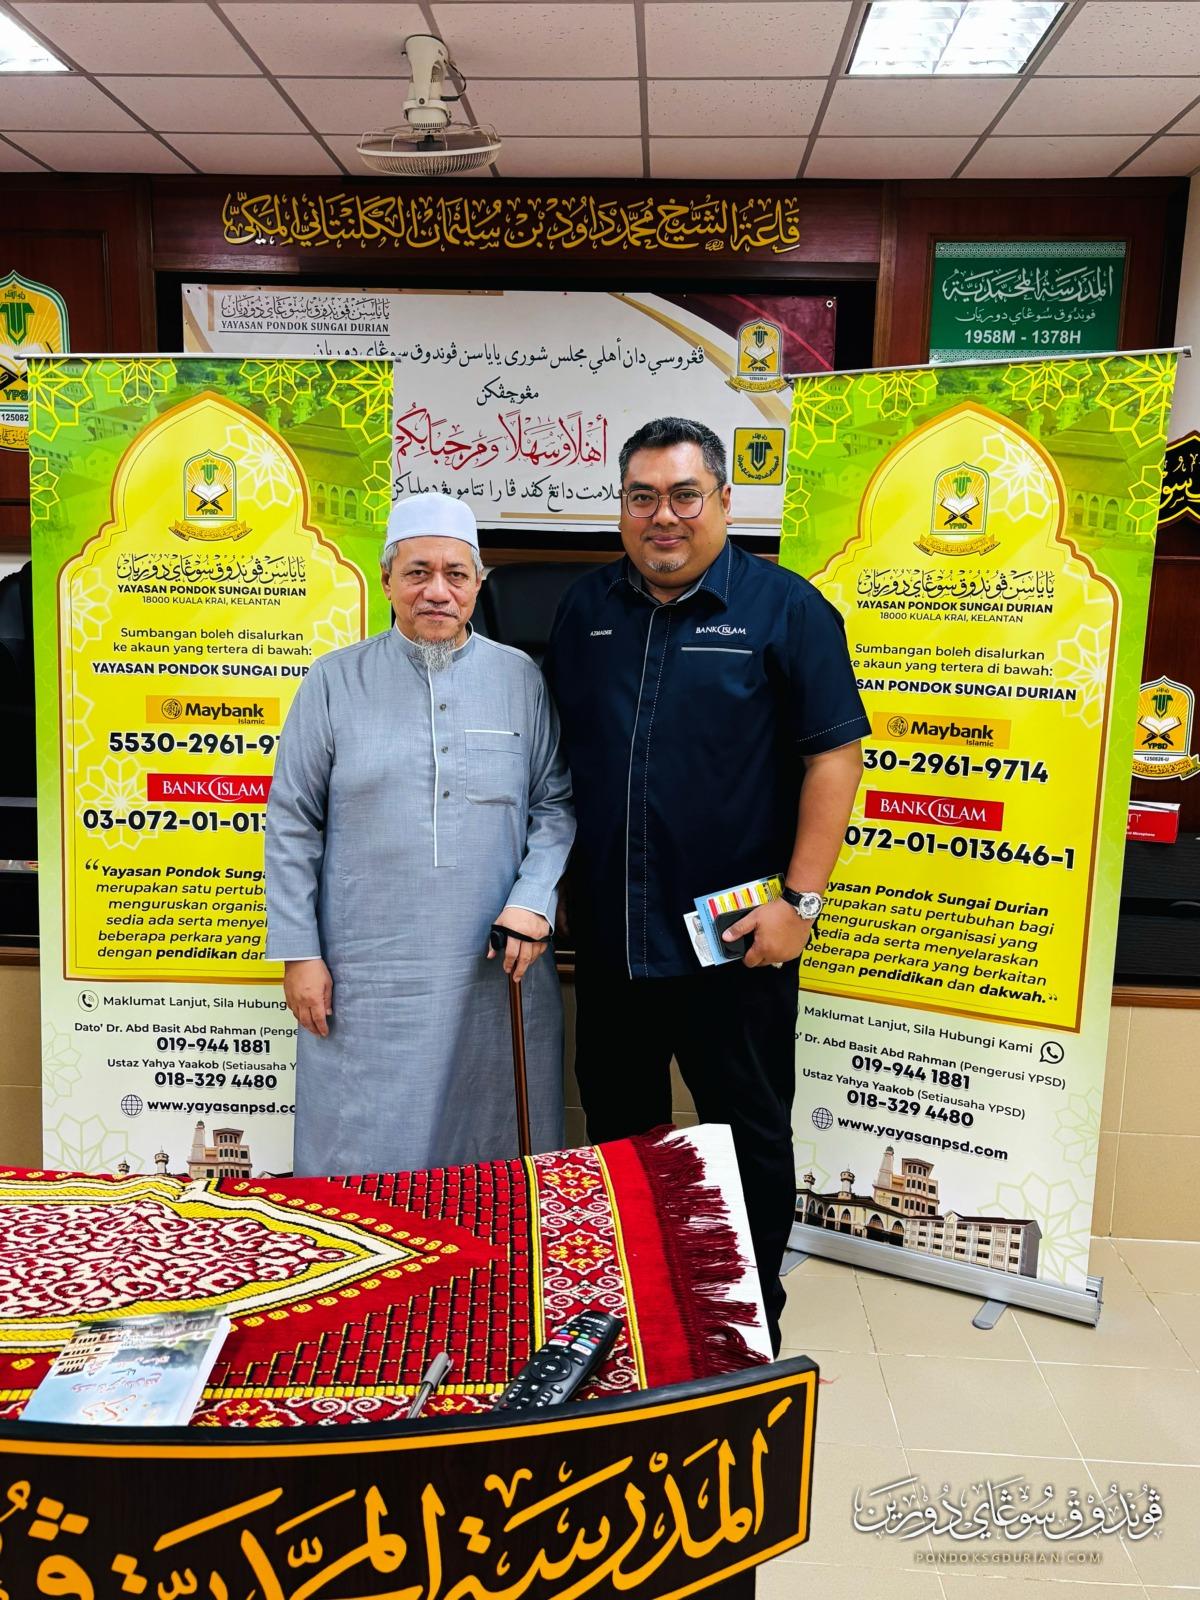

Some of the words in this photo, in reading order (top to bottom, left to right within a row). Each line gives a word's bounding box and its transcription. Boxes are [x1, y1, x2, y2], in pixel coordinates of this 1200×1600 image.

[221, 320, 263, 330] YAYASAN
[267, 321, 308, 331] PONDOK
[311, 322, 347, 332] SUNGAI
[350, 323, 388, 332] DURIAN
[964, 330, 1016, 344] 1958M
[1031, 330, 1081, 344] 1378H
[117, 584, 167, 594] YAYASAN
[170, 585, 216, 594] PONDOK
[218, 586, 261, 595] SUNGAI
[264, 587, 306, 596] DURIAN
[142, 596, 170, 604] 18000
[172, 596, 203, 604] KUALA
[205, 597, 228, 606] KRAI,
[231, 597, 281, 606] KELANTAN
[857, 600, 905, 609] YAYASAN
[908, 601, 957, 611] PONDOK
[959, 602, 1003, 612] SUNGAI
[1006, 603, 1053, 613] DURIAN
[880, 611, 907, 620] 18000
[909, 613, 942, 621] KUALA
[944, 614, 968, 622] KRAI,
[971, 614, 1023, 623] KELANTAN
[121, 627, 197, 641] Sumbangan
[201, 629, 234, 639] boleh
[238, 629, 303, 641] disalurkan
[696, 626, 718, 635] BANK
[721, 626, 747, 636] ISLAM
[113, 642, 127, 652] ke
[130, 642, 170, 653] akaun
[173, 645, 203, 656] yang
[206, 644, 248, 654] tertera
[252, 644, 263, 654] di
[267, 645, 312, 656] bawah:
[855, 643, 931, 657] Sumbangan
[936, 646, 971, 657] boleh
[974, 647, 1045, 660] disalurkan
[92, 662, 154, 674] YAYASAN
[158, 663, 219, 675] PONDOK
[222, 664, 277, 676] SUNGAI
[863, 658, 902, 669] akaun
[905, 662, 937, 673] yang
[941, 662, 983, 673] tertera
[987, 663, 1000, 674] di
[1004, 664, 1053, 676] bawah:
[888, 680, 952, 694] PONDOK
[955, 683, 1012, 697] SUNGAI
[1016, 686, 1076, 700] DURIAN
[185, 703, 264, 720] Maybank
[911, 721, 993, 740] Maybank
[109, 732, 281, 755] 5530-2961-9
[966, 739, 993, 747] Islamic
[163, 780, 208, 795] BANK
[217, 782, 264, 796] ISLAM
[880, 798, 927, 816] BANK
[936, 803, 987, 823] ISLAM
[166, 866, 221, 878] Pondok
[96, 882, 178, 895] merupakan
[182, 884, 212, 894] satu
[108, 898, 208, 912] menguruskan
[875, 885, 934, 902] Pondok
[937, 893, 991, 910] Sungai
[994, 900, 1048, 917] Durian
[106, 914, 144, 925] sedia
[148, 914, 174, 925] ada
[178, 916, 213, 926] serta
[890, 905, 922, 917] satu
[925, 908, 1017, 931] pertubuhan
[1019, 920, 1055, 937] bagi
[98, 930, 166, 944] beberapa
[169, 931, 223, 944] perkara
[225, 935, 261, 947] yang
[818, 912, 917, 935] menguruskan
[920, 923, 996, 946] organisasi
[997, 937, 1038, 952] yang
[97, 946, 152, 960] dengan
[156, 947, 237, 960] pendidikan
[853, 933, 880, 945] ada
[883, 938, 920, 950] serta
[924, 941, 1038, 969] menyelaraskan
[802, 941, 870, 962] beberapa
[873, 953, 929, 968] perkara
[931, 961, 969, 977] yang
[973, 964, 1046, 986] berkaitan
[803, 955, 855, 974] dengan
[858, 965, 943, 987] pendidikan
[947, 979, 975, 992] dan
[103, 996, 166, 1006] Maklumat
[169, 997, 210, 1009] Lanjut,
[213, 997, 234, 1008] Sila
[238, 998, 288, 1011] Hubung
[75, 1022, 103, 1032] Dato'
[106, 1024, 123, 1032] Dr.
[125, 1024, 149, 1033] Abd
[152, 1024, 181, 1033] Basit
[184, 1025, 207, 1034] Abd
[210, 1025, 256, 1035] Rahman
[804, 1006, 864, 1024] Maklumat
[868, 1016, 910, 1033] Lanjut,
[913, 1024, 935, 1036] Sila
[939, 1028, 995, 1049] Hubungi
[999, 1039, 1033, 1053] Kami
[157, 1037, 229, 1052] 019-944
[233, 1039, 270, 1053] 1881
[107, 1059, 139, 1067] Ustaz
[142, 1059, 175, 1070] Yahya
[178, 1060, 219, 1069] Yaakob
[222, 1061, 287, 1071] (Setiausaha
[805, 1033, 820, 1044] Dr.
[822, 1037, 846, 1048] Abd
[849, 1041, 877, 1054] Basit
[880, 1047, 904, 1059] Abd
[907, 1051, 956, 1069] Rahman
[960, 1061, 1025, 1083] (Pengerusi
[1028, 1073, 1066, 1090] YPSD)
[155, 1072, 226, 1087] 018-329
[231, 1074, 277, 1088] 4480
[852, 1055, 926, 1082] 019-944
[931, 1067, 972, 1089] 1881
[803, 1068, 833, 1082] Ustaz
[836, 1074, 869, 1089] Yahya
[872, 1081, 914, 1098] Yaakob
[917, 1089, 985, 1111] (Setiausaha
[988, 1103, 1025, 1120] YPSD)
[847, 1089, 921, 1116] 018-329
[925, 1105, 978, 1126] 4480
[837, 1115, 1009, 1161] www.yayasanpsd.com
